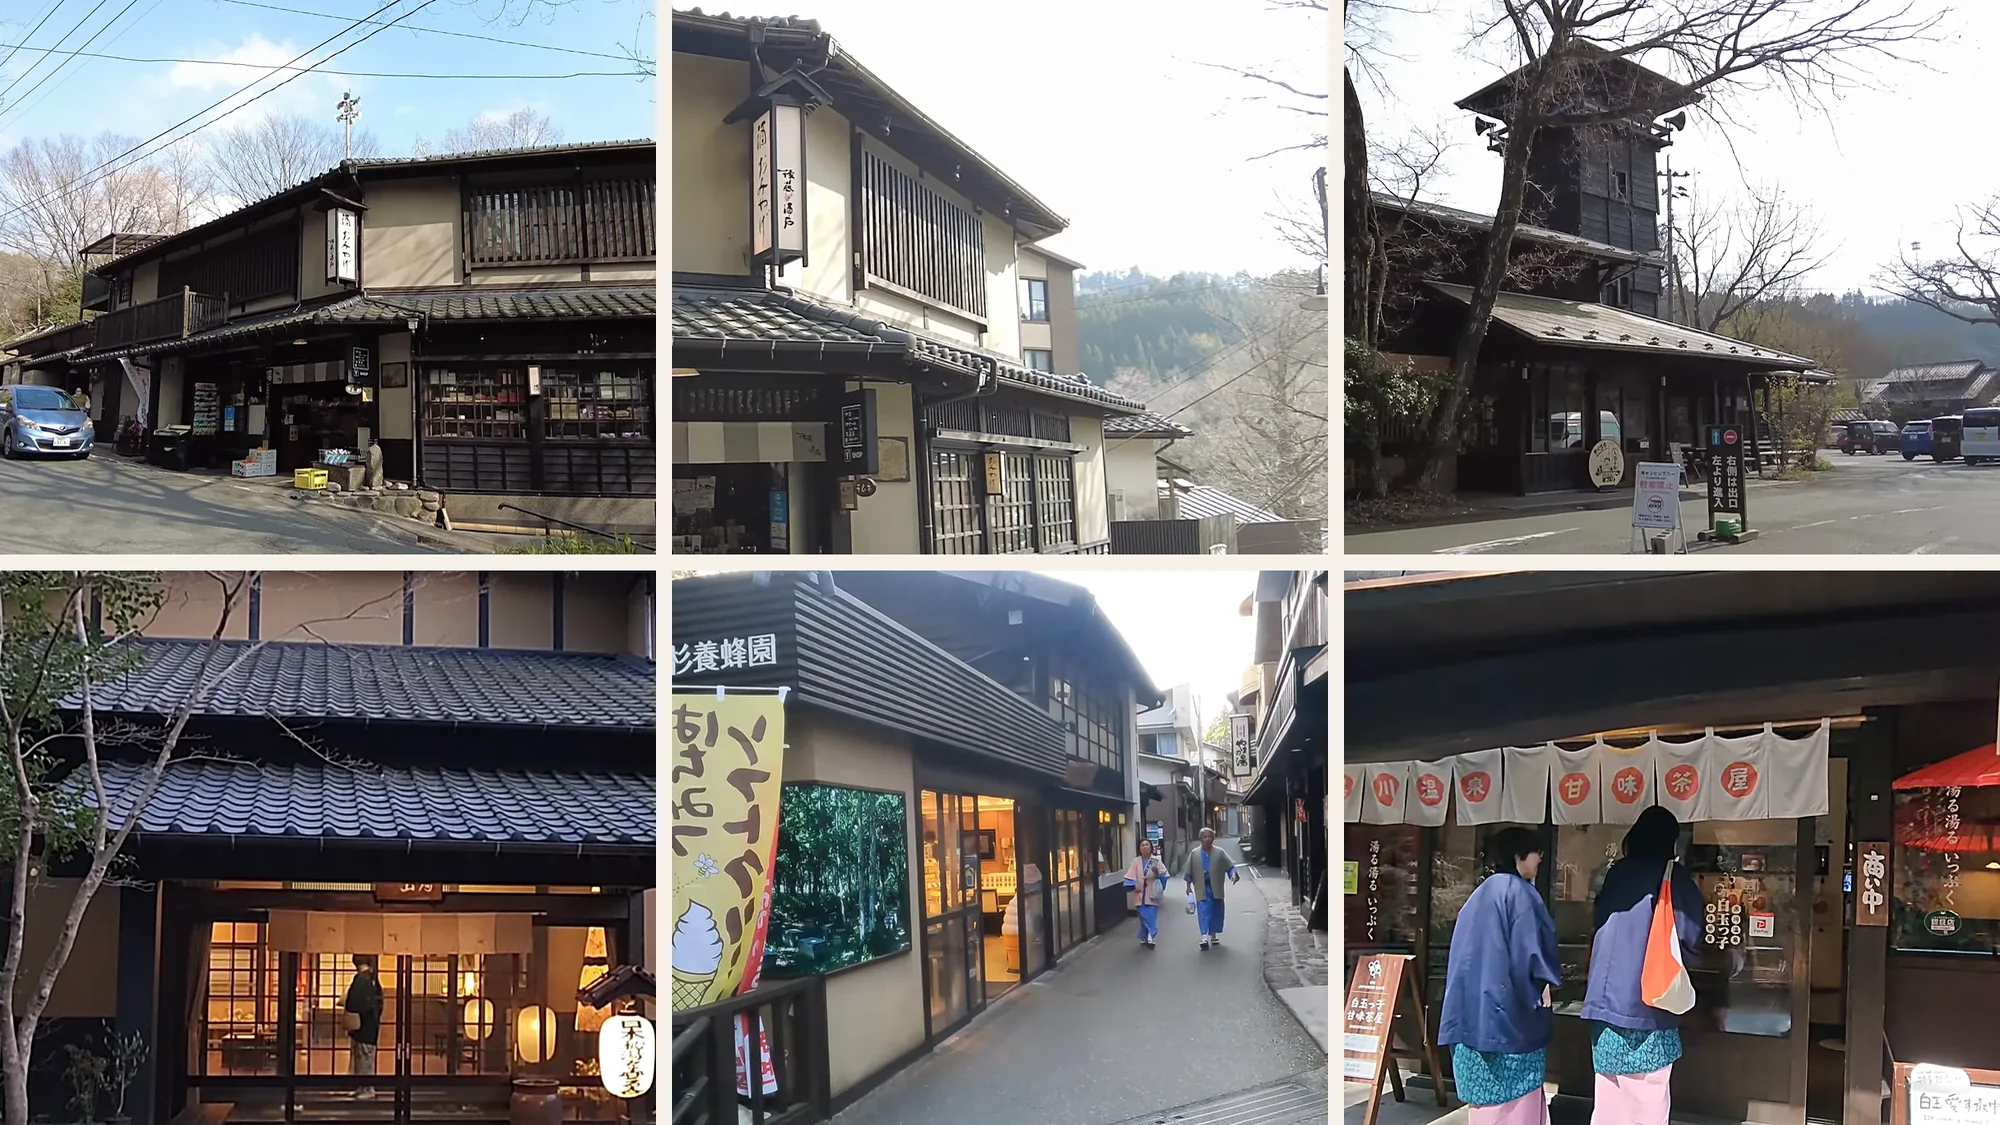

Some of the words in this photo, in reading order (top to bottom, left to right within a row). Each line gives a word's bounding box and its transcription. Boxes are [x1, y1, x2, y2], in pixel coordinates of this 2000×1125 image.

[1712, 455, 1724, 508] 左より進入
[1726, 455, 1738, 508] 右側は出口
[1862, 850, 1886, 915] 商い中
[1351, 997, 1386, 1011] 白玉っ子
